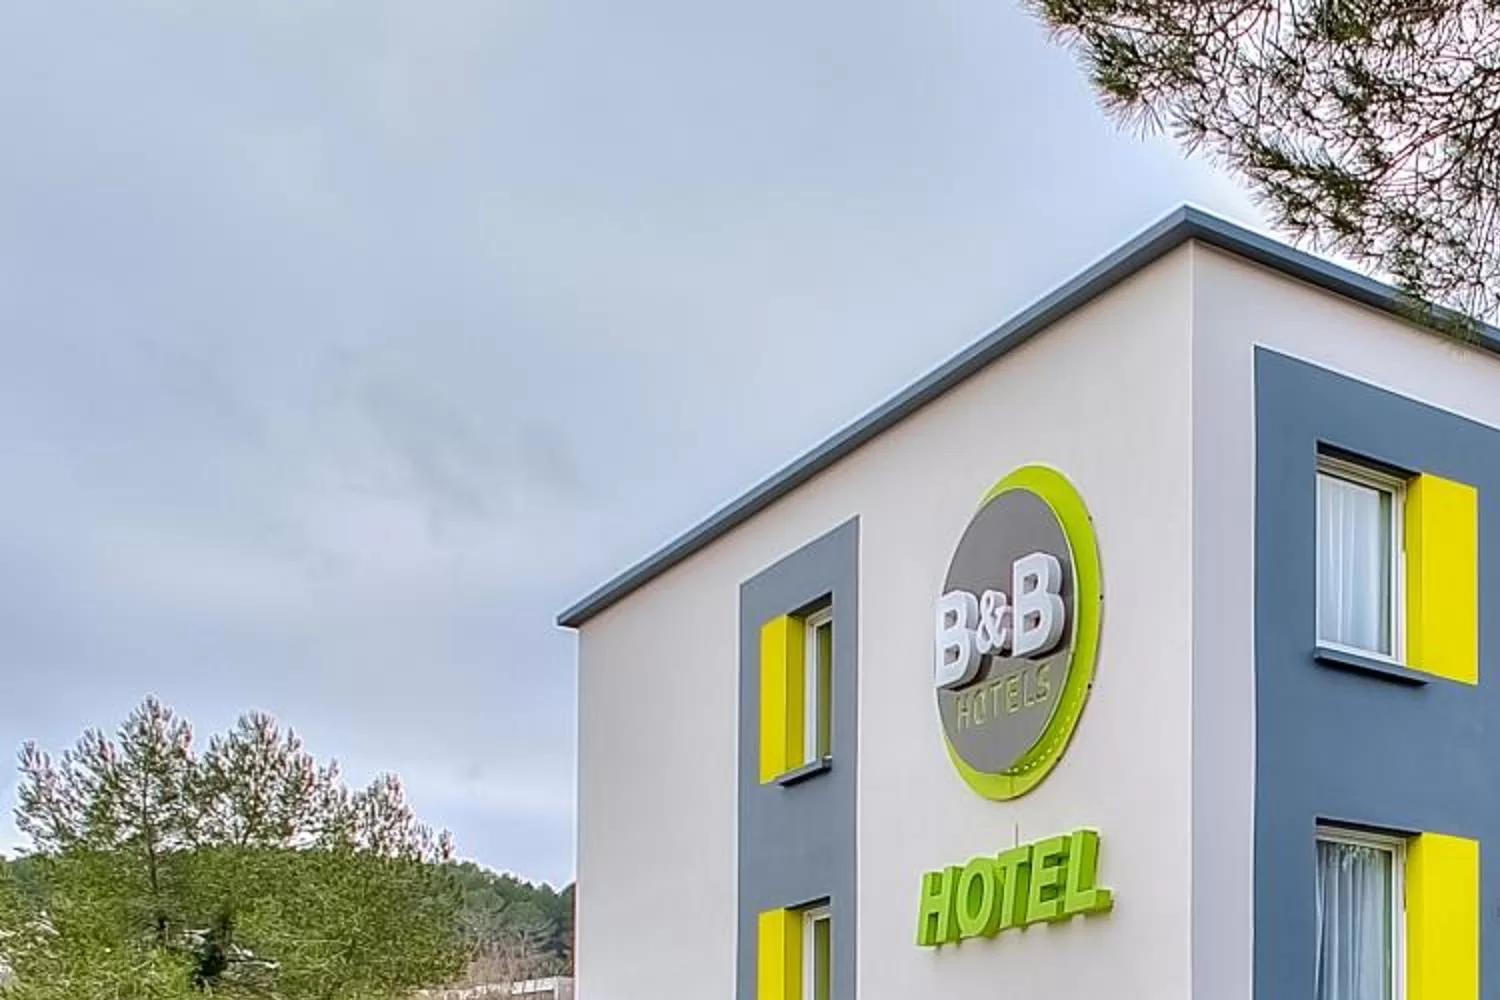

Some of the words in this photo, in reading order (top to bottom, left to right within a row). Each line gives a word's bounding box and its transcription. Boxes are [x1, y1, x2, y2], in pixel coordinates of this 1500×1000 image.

[935, 552, 1065, 690] B&B
[954, 661, 1052, 733] HOTELS
[917, 828, 1112, 947] HOTEL
